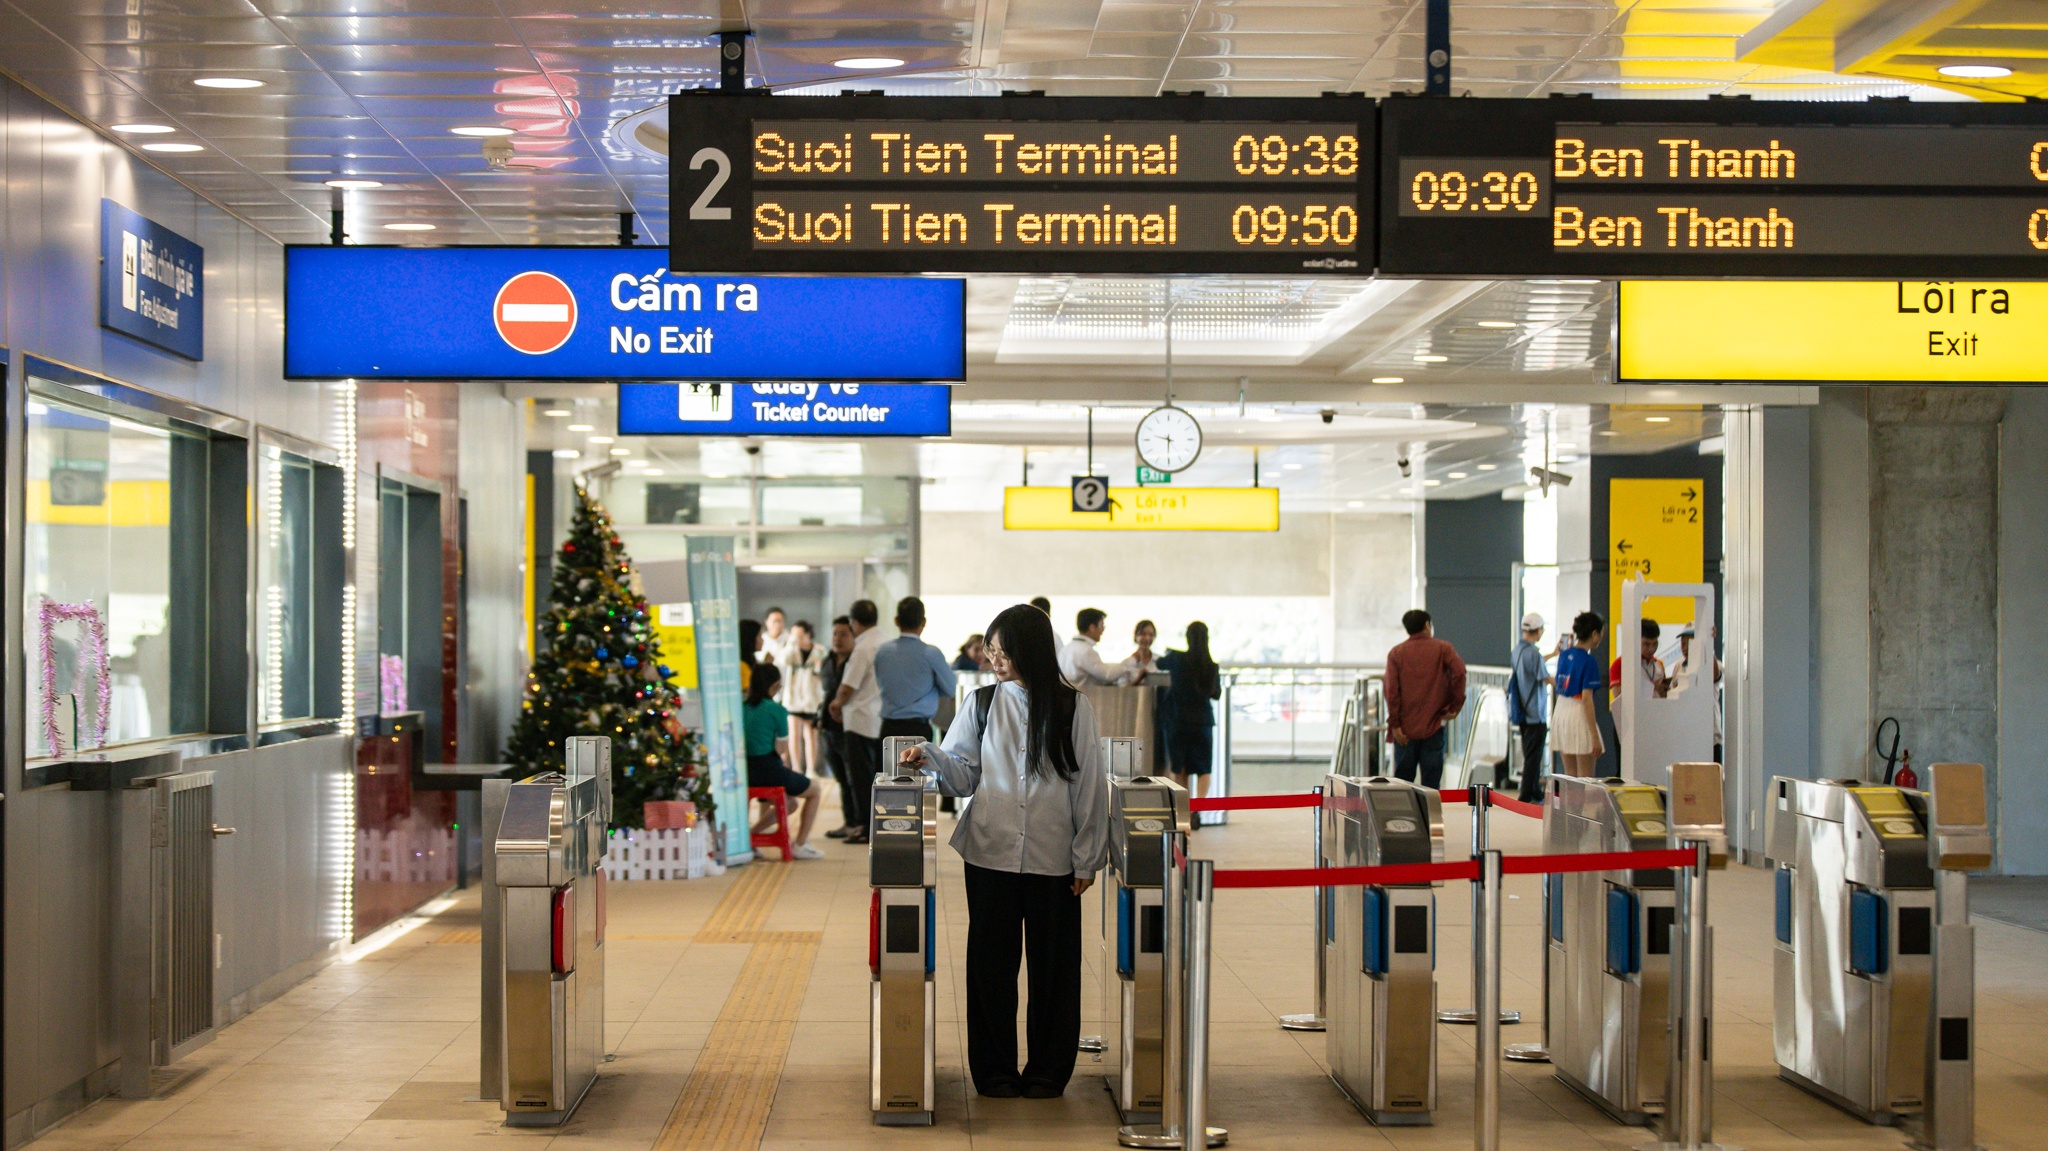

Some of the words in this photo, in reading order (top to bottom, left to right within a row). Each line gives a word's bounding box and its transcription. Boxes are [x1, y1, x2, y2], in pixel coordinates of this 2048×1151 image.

[754, 133, 851, 173] Suoi
[871, 133, 967, 173] Tien
[984, 134, 1177, 174] Terminal
[1233, 135, 1359, 175] 09:38
[1555, 139, 1643, 178] Ben
[1658, 139, 1796, 178] Thanh
[690, 148, 731, 220] 2
[1412, 172, 1538, 212] 09:30
[754, 203, 851, 243] Suoi
[871, 203, 967, 243] Tien
[983, 204, 1177, 244] Terminal
[1232, 205, 1358, 245] 09:50
[1554, 207, 1642, 246] Ben
[1657, 207, 1795, 247] Thanh
[611, 268, 701, 312] Cấm
[716, 283, 758, 312] ra
[1972, 289, 2009, 315] ra
[610, 326, 650, 354] No
[660, 326, 714, 354] Exit
[1929, 331, 1978, 356] Exit
[752, 402, 809, 421] Ticket
[813, 402, 890, 421] Counter
[1162, 498, 1176, 508] ra
[1688, 507, 1697, 523] 2
[1641, 559, 1651, 575] 3
